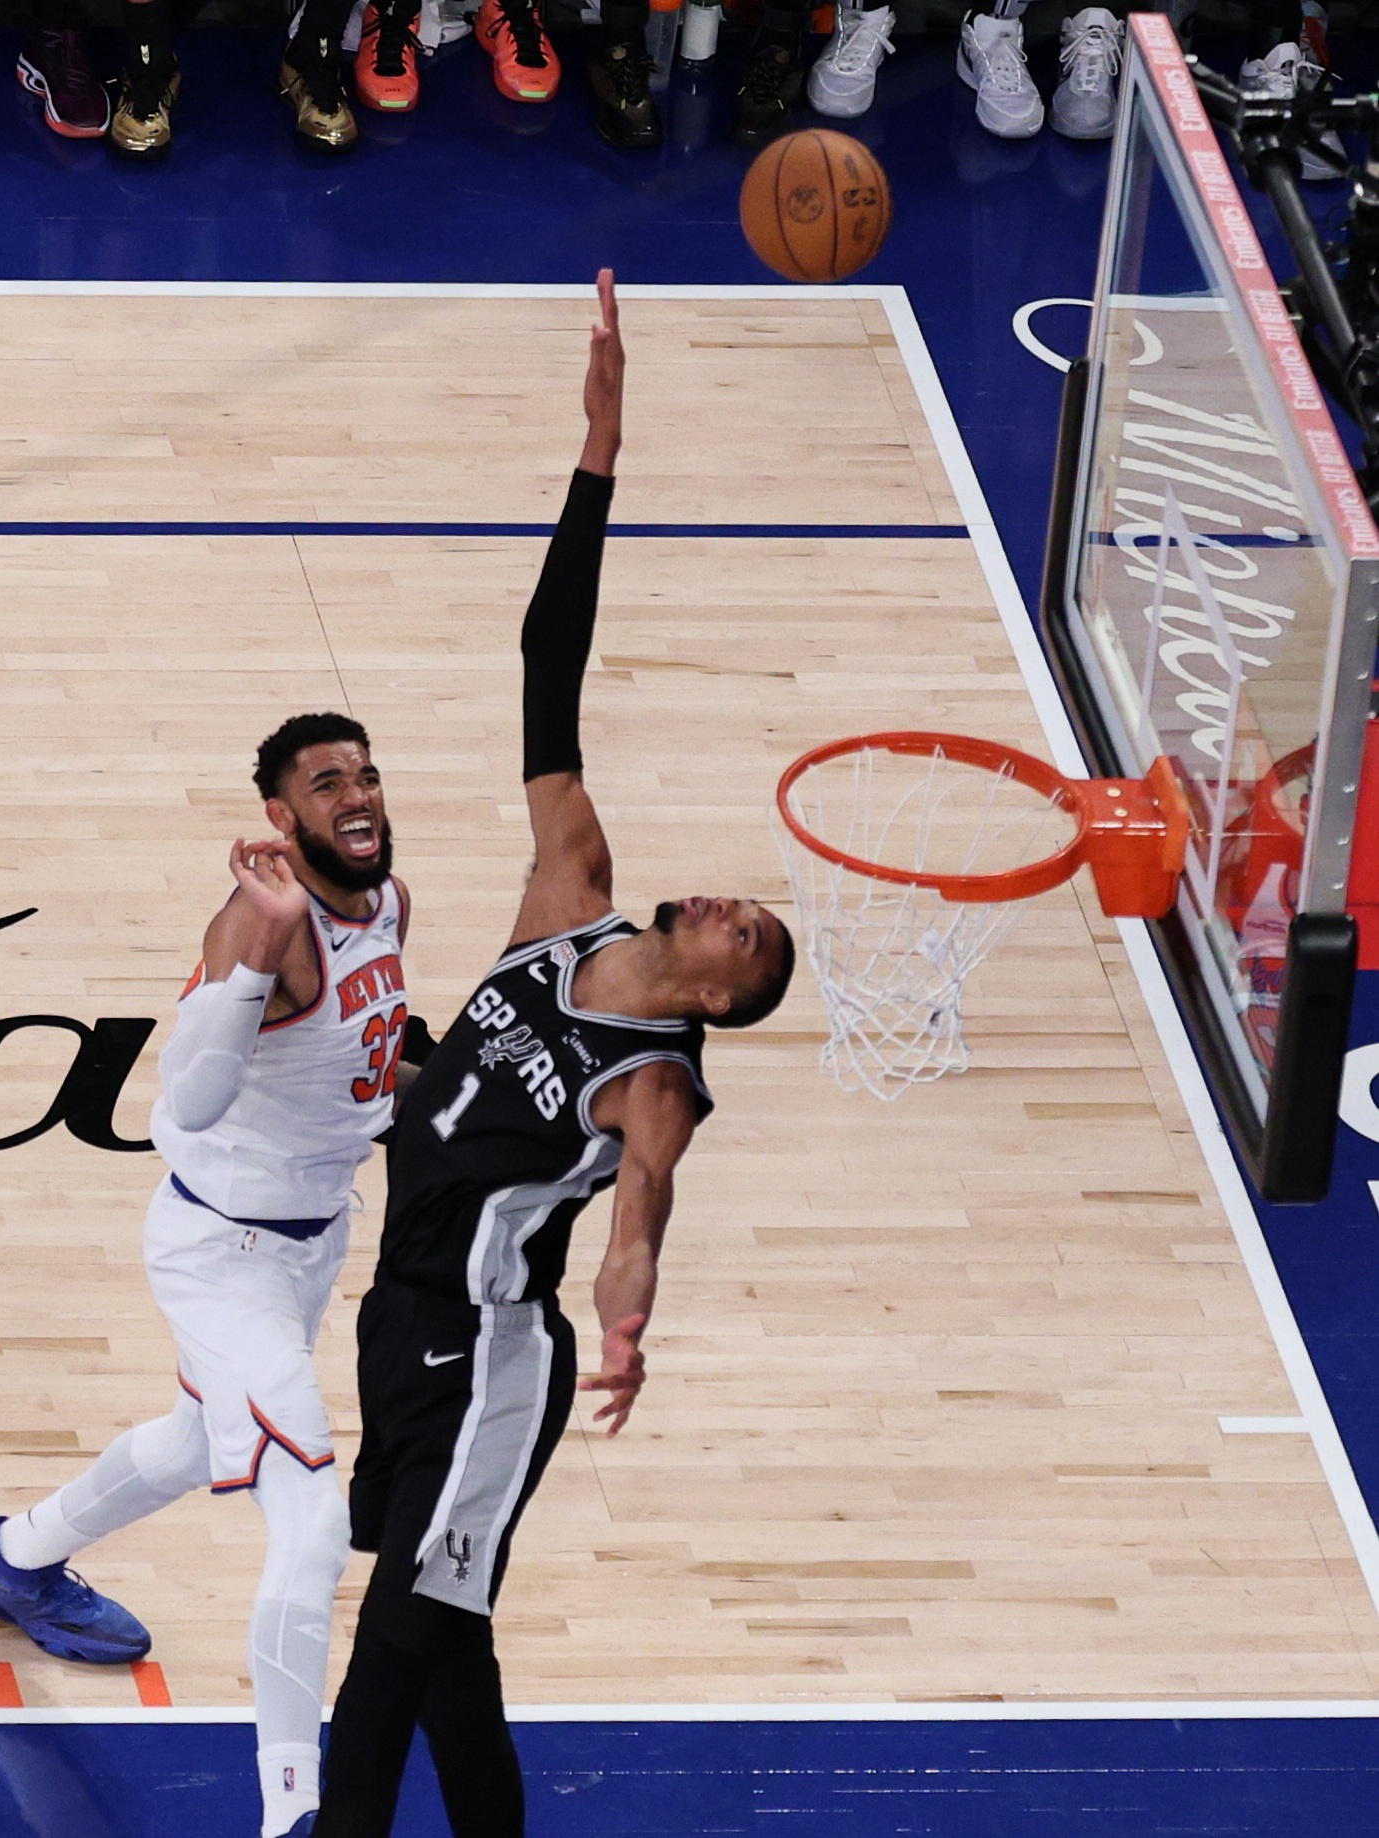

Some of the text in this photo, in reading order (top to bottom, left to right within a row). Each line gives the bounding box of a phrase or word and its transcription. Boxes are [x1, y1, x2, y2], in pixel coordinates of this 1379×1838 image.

[1163, 69, 1209, 132] Emirates
[1220, 205, 1264, 270] Emirates
[1276, 346, 1322, 411] Emirates
[1335, 488, 1379, 552] Emirates
[336, 962, 380, 1023] NEW
[351, 1002, 408, 1104] 32
[467, 986, 567, 1121] SPURS
[430, 1072, 482, 1142] 1
